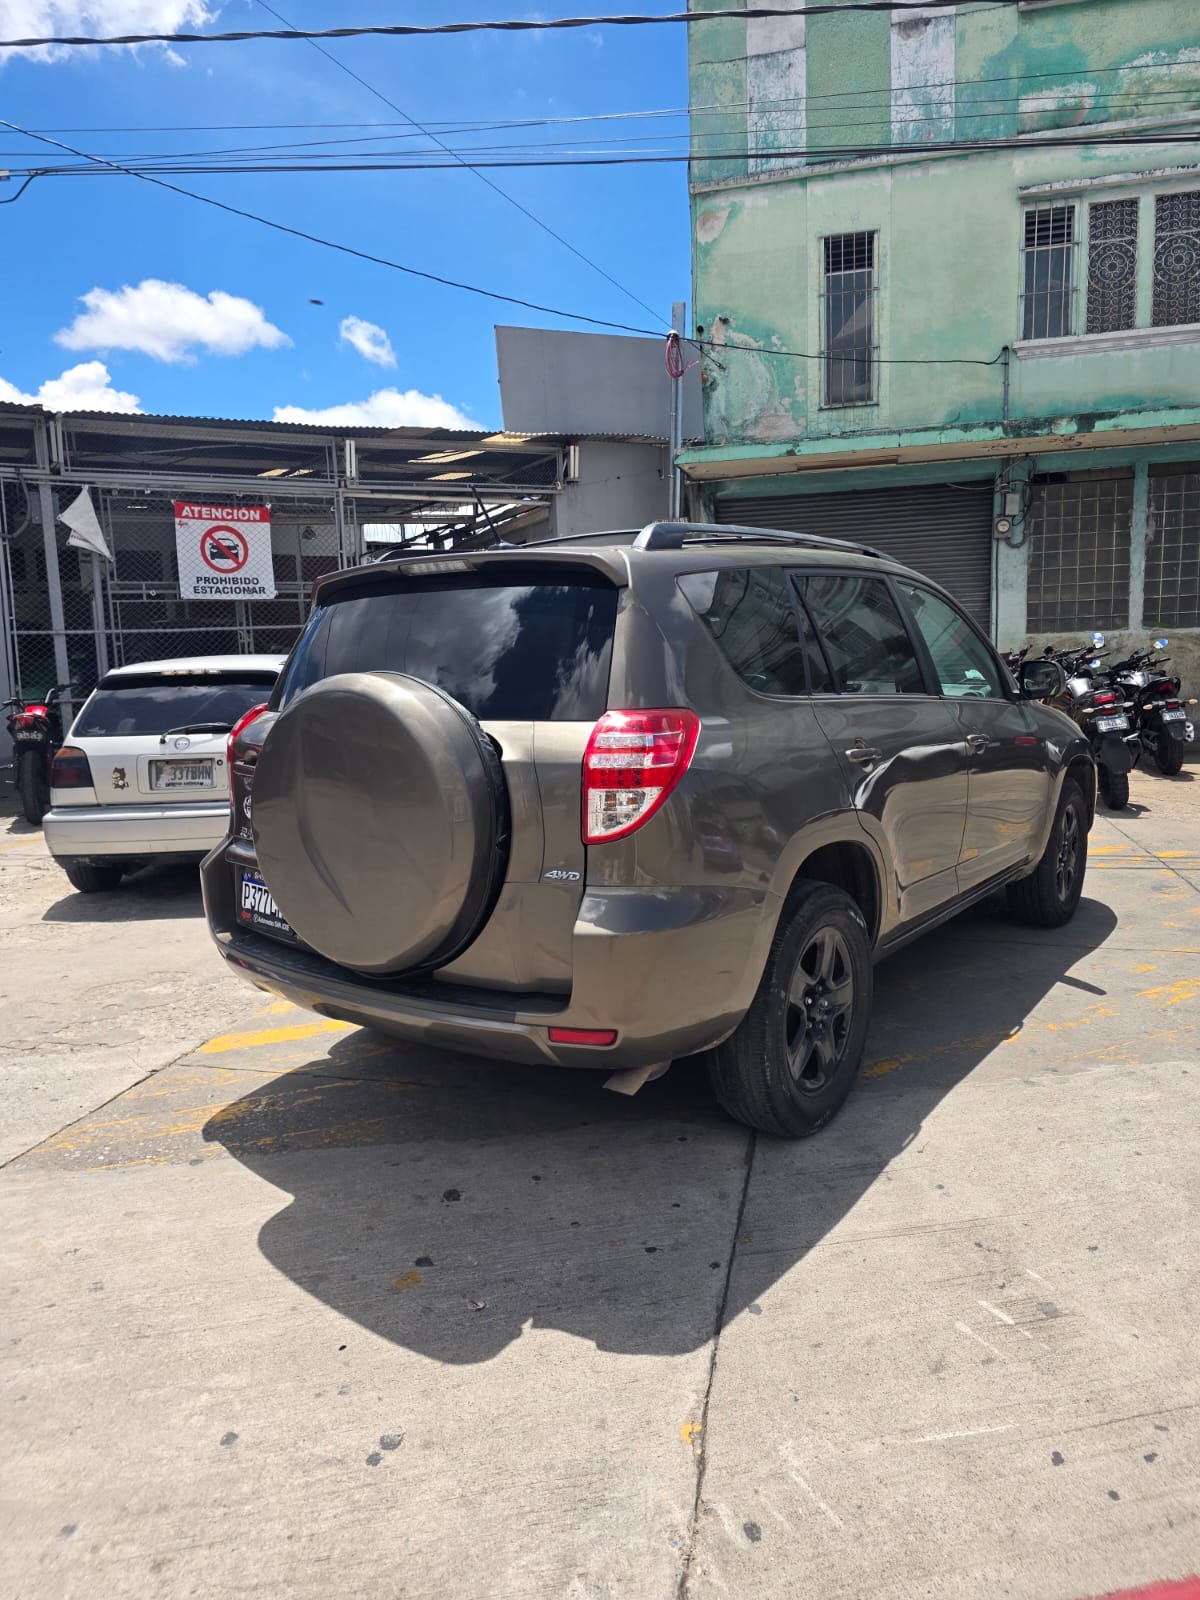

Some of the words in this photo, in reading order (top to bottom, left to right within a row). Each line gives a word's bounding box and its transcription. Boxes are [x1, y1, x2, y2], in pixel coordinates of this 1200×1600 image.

[181, 505, 260, 521] ATENCIÓN
[196, 576, 259, 585] PROHIBIDO
[193, 586, 266, 595] ESTACIONAR
[543, 870, 581, 881] 4WD
